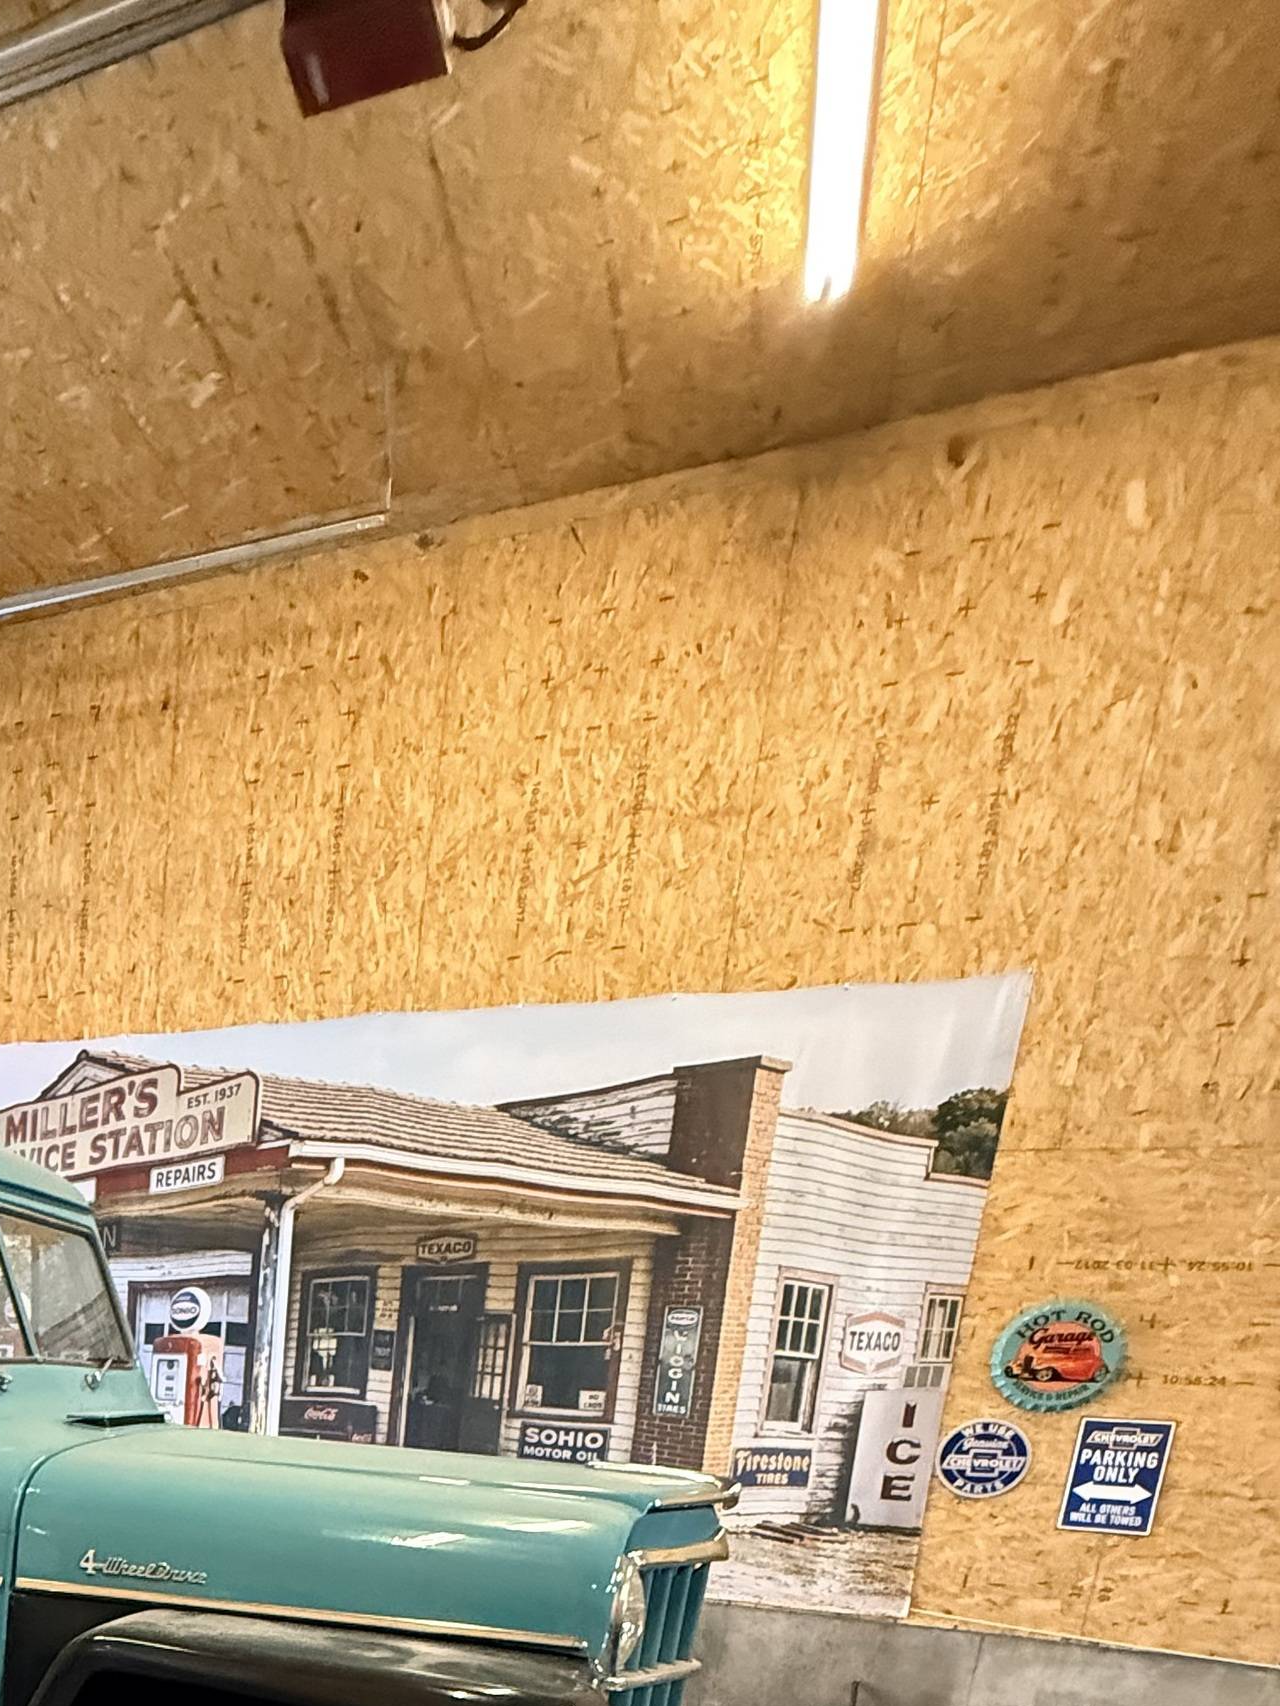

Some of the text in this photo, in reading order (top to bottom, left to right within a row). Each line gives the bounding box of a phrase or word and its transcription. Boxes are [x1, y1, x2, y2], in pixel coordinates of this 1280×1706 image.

[187, 1083, 241, 1109] EST. 1937
[5, 1078, 158, 1147] MILLER'S
[89, 1106, 225, 1166] STATION
[156, 1162, 216, 1188] REPAIRS
[420, 1241, 472, 1255] TEXACO
[1015, 1309, 1114, 1343] HOT ROD
[850, 1331, 901, 1351] TEXACO
[1029, 1328, 1096, 1349] Garage
[657, 1403, 686, 1415] TIRES
[524, 1427, 604, 1449] SOHIO
[960, 1423, 1015, 1439] WE USE
[1094, 1433, 1156, 1444] CHEVROLET
[880, 1401, 921, 1501] ICE
[962, 1437, 1008, 1451] Genuine
[523, 1446, 600, 1462] MOTOR OIL
[1080, 1448, 1159, 1469] PARKING
[735, 1450, 810, 1476] Firestone
[949, 1458, 1022, 1469] CHEVROLET
[755, 1473, 789, 1485] TIRES
[1093, 1466, 1139, 1483] ONLY
[952, 1478, 1005, 1494] PARTS
[1080, 1503, 1136, 1516] ALL OTHERS
[1069, 1512, 1142, 1527] WILL BE TOWED
